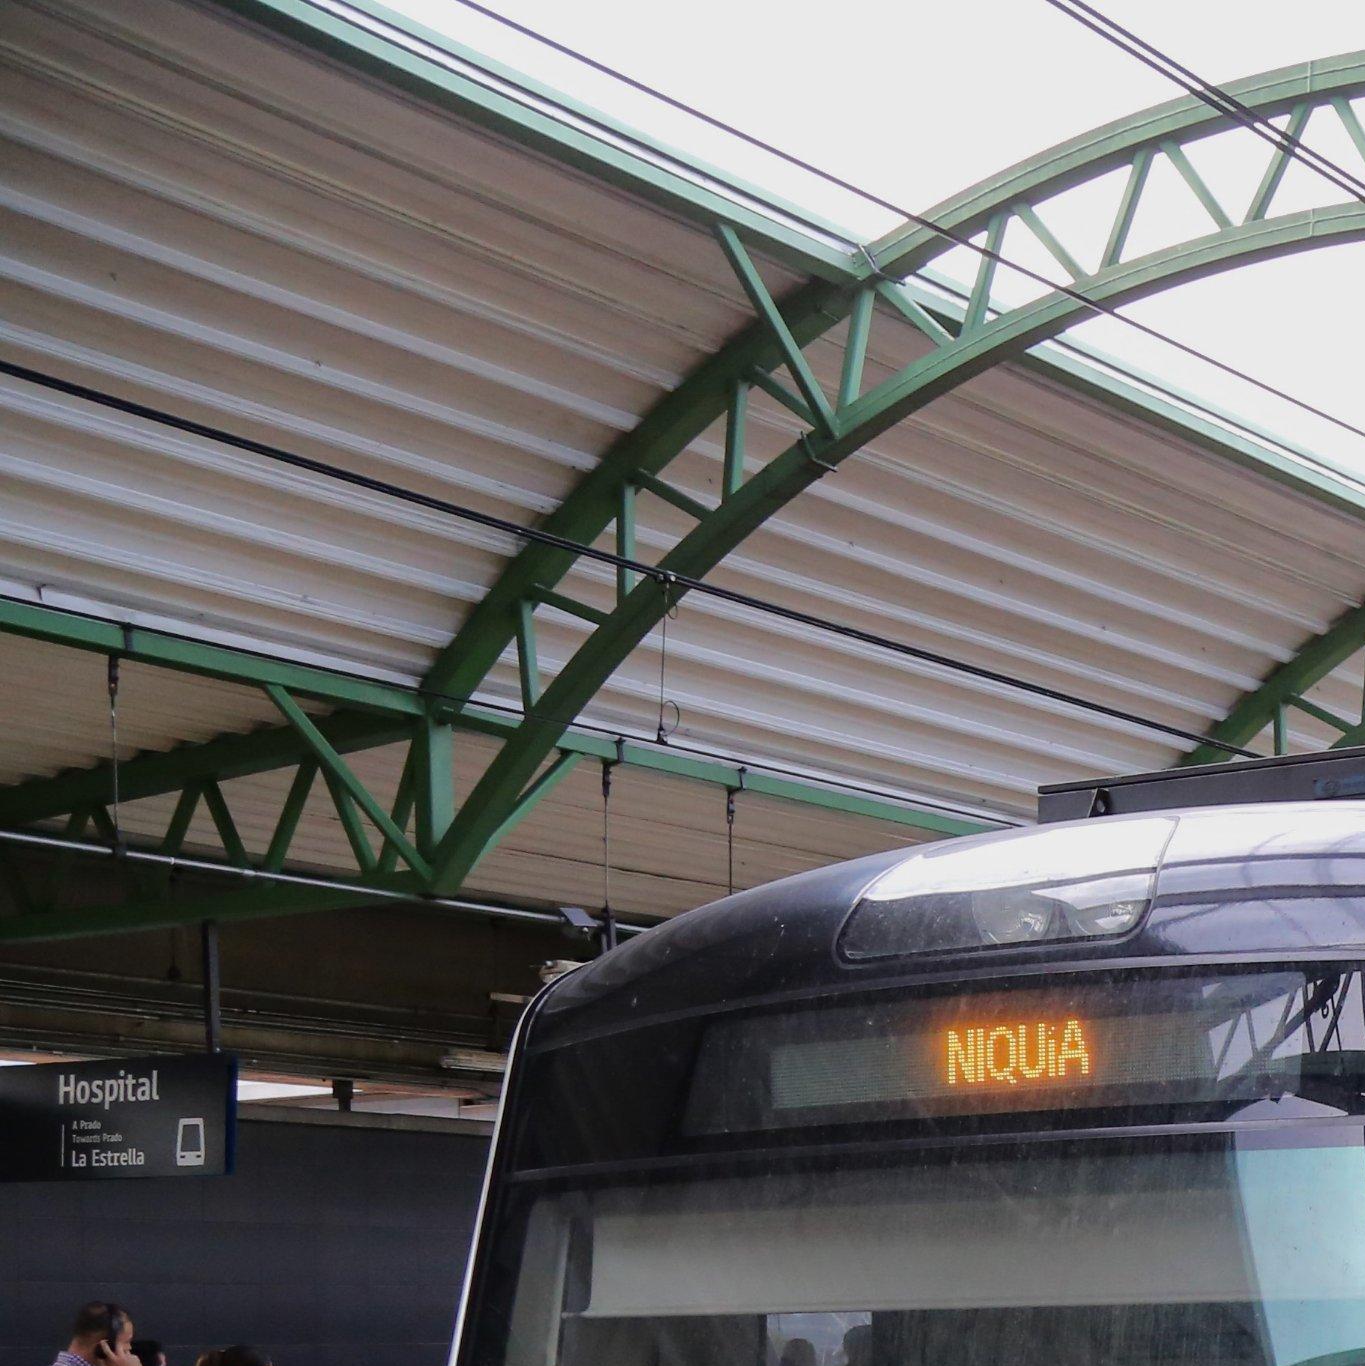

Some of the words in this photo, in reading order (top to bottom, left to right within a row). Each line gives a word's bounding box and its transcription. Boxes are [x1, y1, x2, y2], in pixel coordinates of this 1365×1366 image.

[59, 1070, 160, 1110] Hospital
[72, 1120, 78, 1130] A
[80, 1119, 102, 1130] Prado
[72, 1133, 100, 1143] Towards
[102, 1133, 123, 1142] Prado
[71, 1150, 87, 1167] La
[92, 1147, 145, 1167] Estrella
